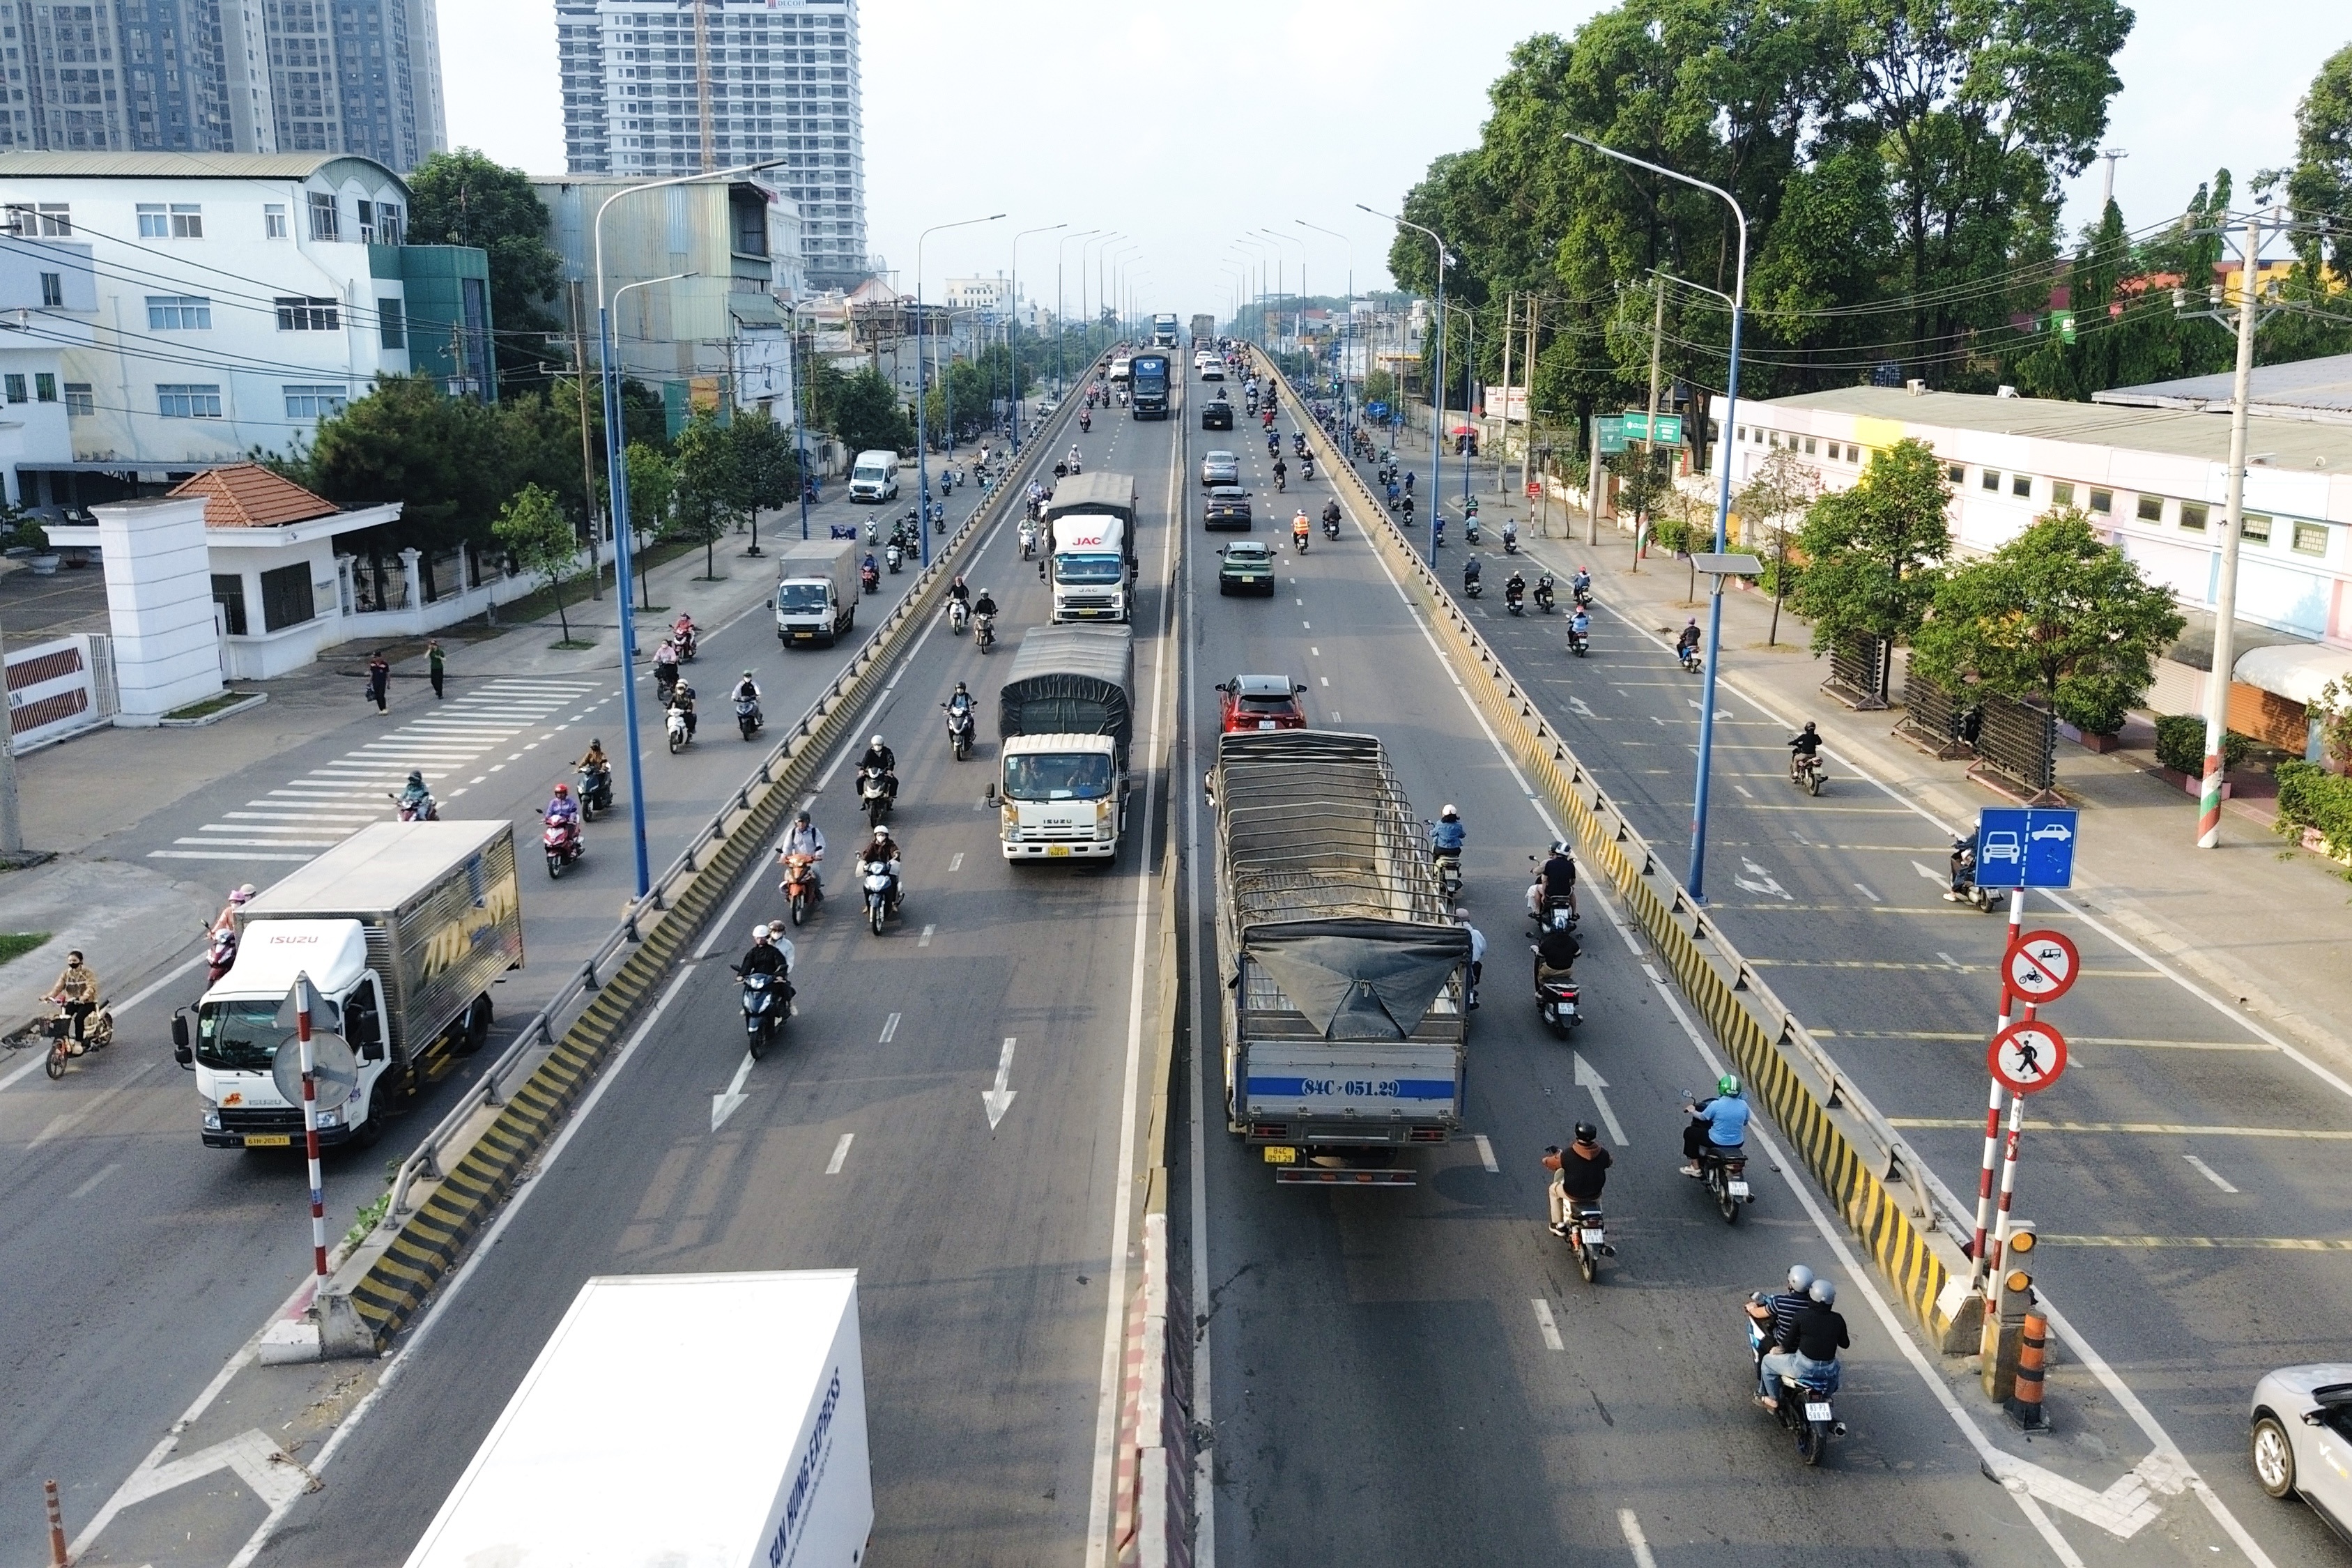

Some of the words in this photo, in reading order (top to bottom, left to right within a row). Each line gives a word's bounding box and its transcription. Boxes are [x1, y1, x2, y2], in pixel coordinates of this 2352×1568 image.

[1072, 537, 1102, 546] JAC
[769, 1514, 786, 1568] TAN
[787, 1453, 809, 1535] HUNG
[809, 1365, 840, 1473] EXPRESS
